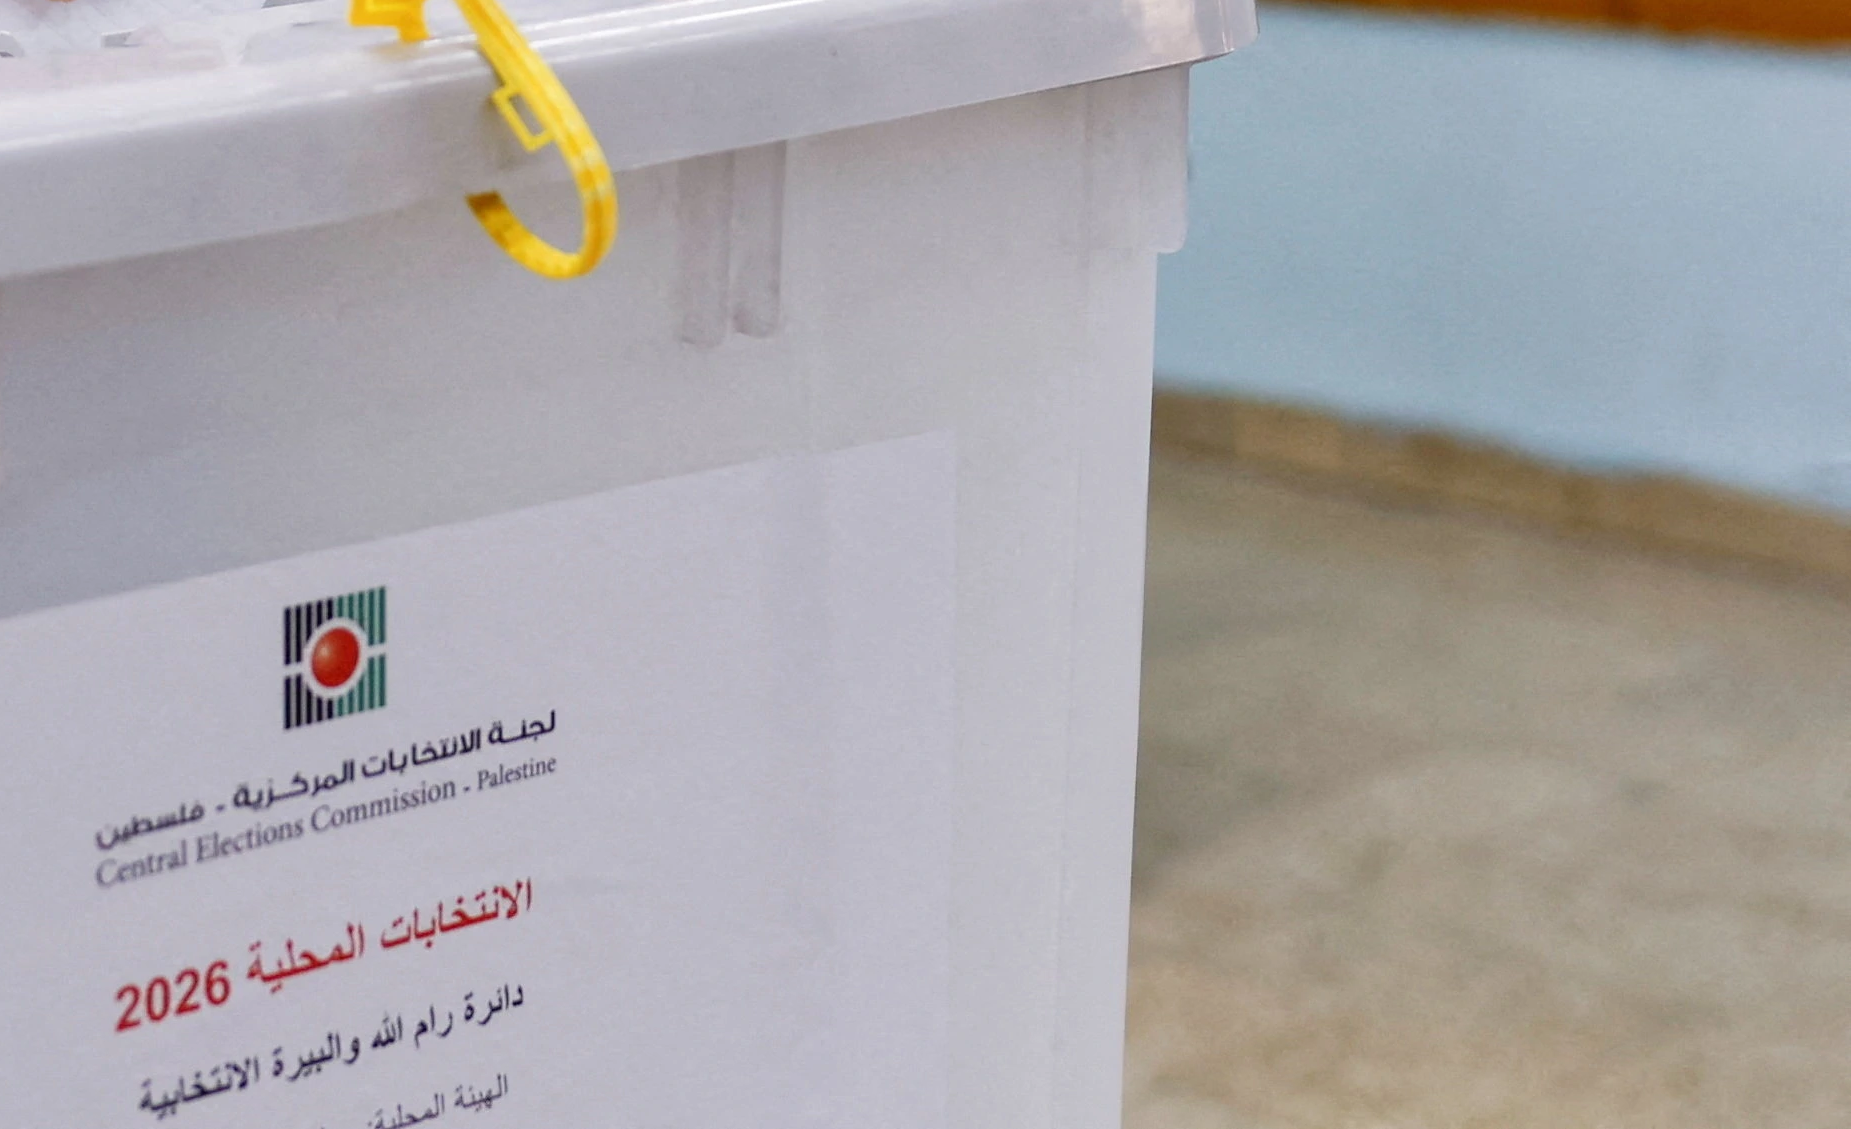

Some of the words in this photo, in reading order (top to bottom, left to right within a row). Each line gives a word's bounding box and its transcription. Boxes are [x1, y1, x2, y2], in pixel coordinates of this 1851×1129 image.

[361, 728, 481, 778] الانتخابات
[96, 840, 187, 885] Central
[196, 822, 304, 862] Elections
[310, 780, 456, 832] Commission
[478, 758, 557, 791] Palestine
[96, 804, 205, 850] فلسطين
[380, 879, 532, 949] الانتخابات
[246, 924, 365, 994] المحلية
[116, 960, 231, 1032] 2026
[464, 984, 524, 1026] دائرة
[371, 1017, 403, 1049] الله
[414, 1009, 453, 1048] رام
[272, 1033, 360, 1082] والبيرة
[140, 1058, 259, 1119] الانتخابية
[454, 1074, 508, 1109] الهيئة
